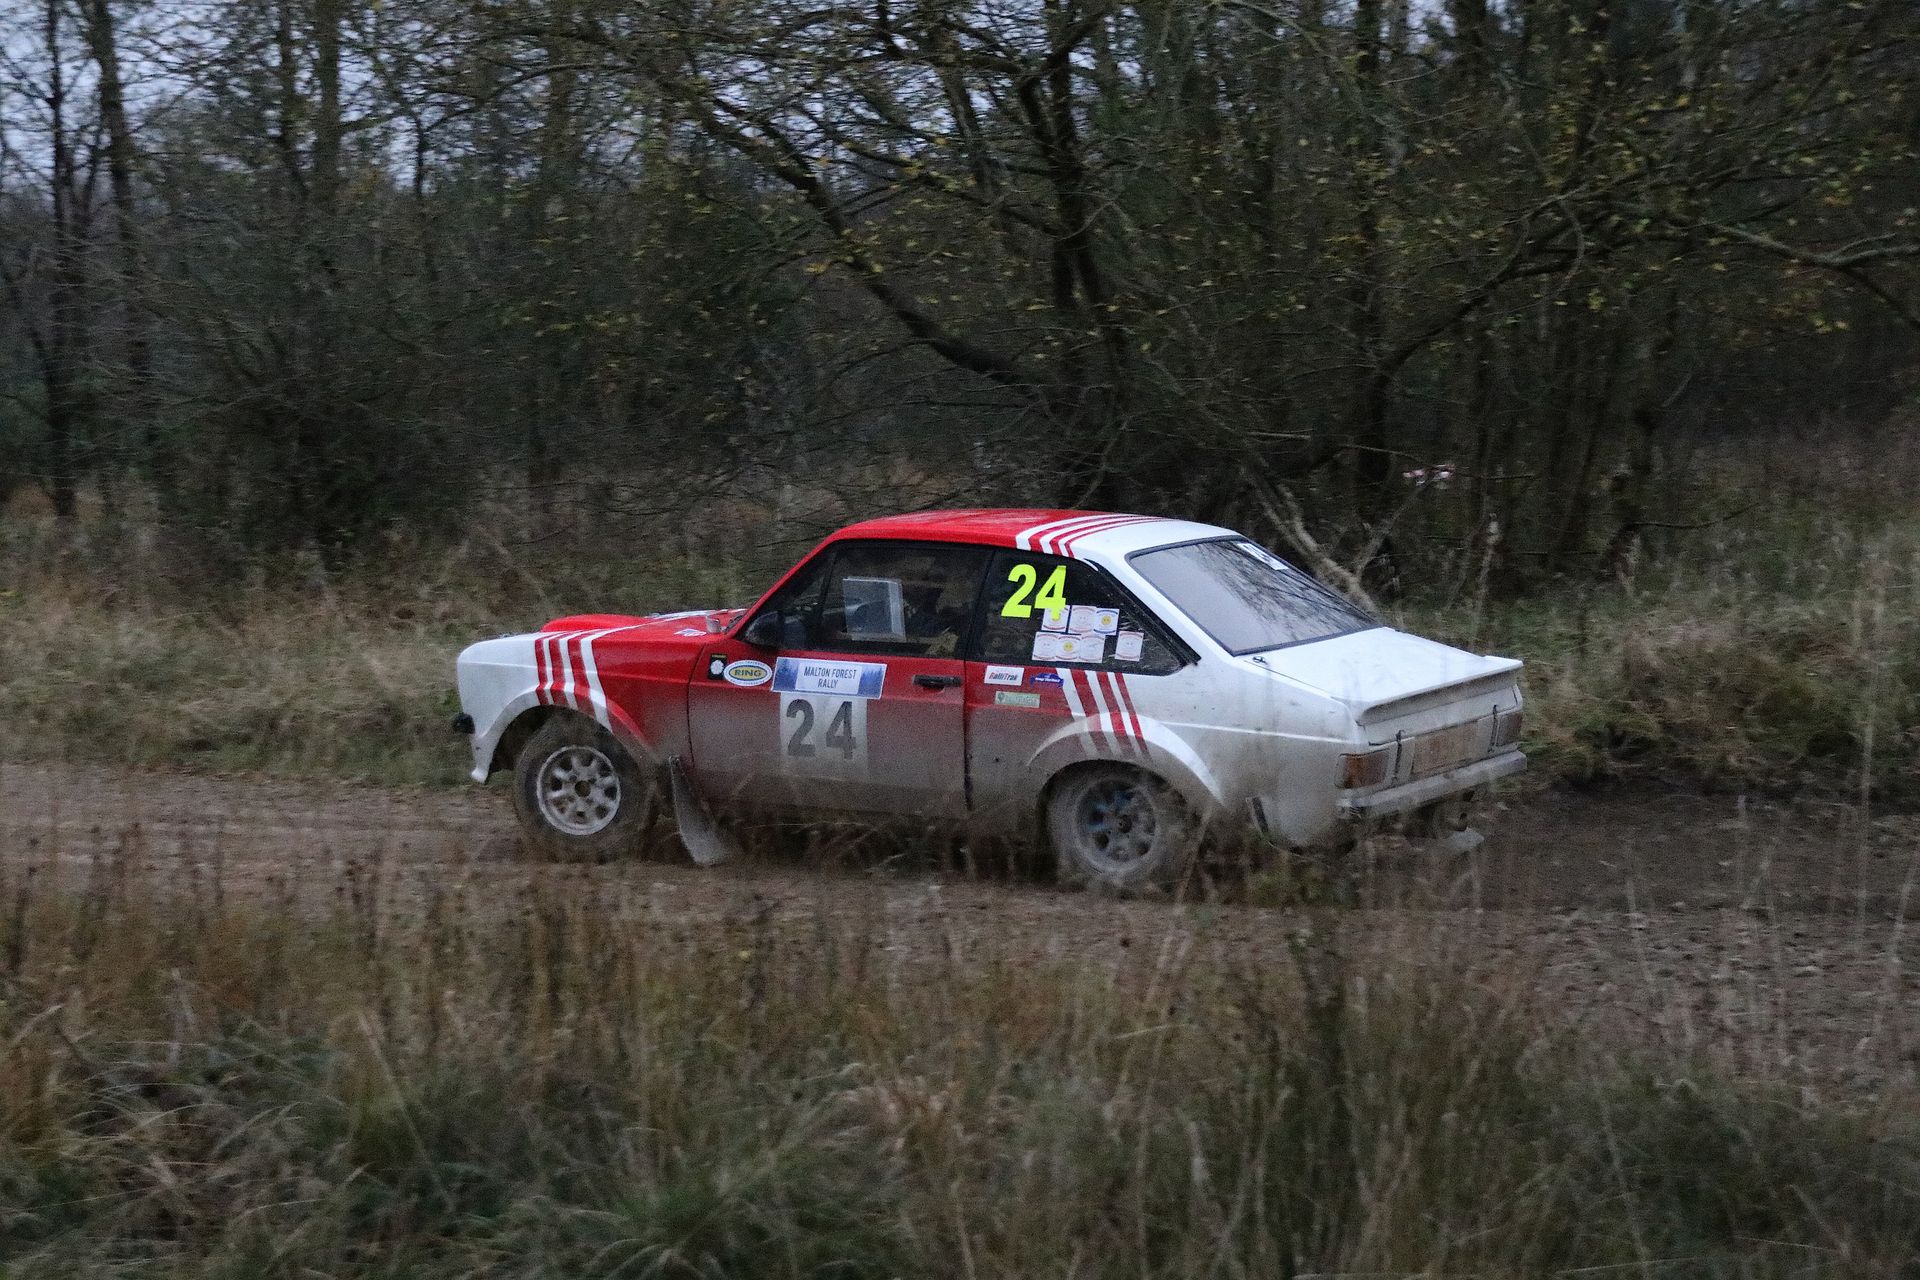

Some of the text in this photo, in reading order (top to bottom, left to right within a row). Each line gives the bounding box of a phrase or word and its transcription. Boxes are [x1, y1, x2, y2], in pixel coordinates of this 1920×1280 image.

[1001, 563, 1067, 621] 24
[734, 669, 763, 677] RING
[804, 666, 857, 680] MALTON FOREST
[817, 678, 839, 689] RALLY
[786, 699, 857, 760] 24
